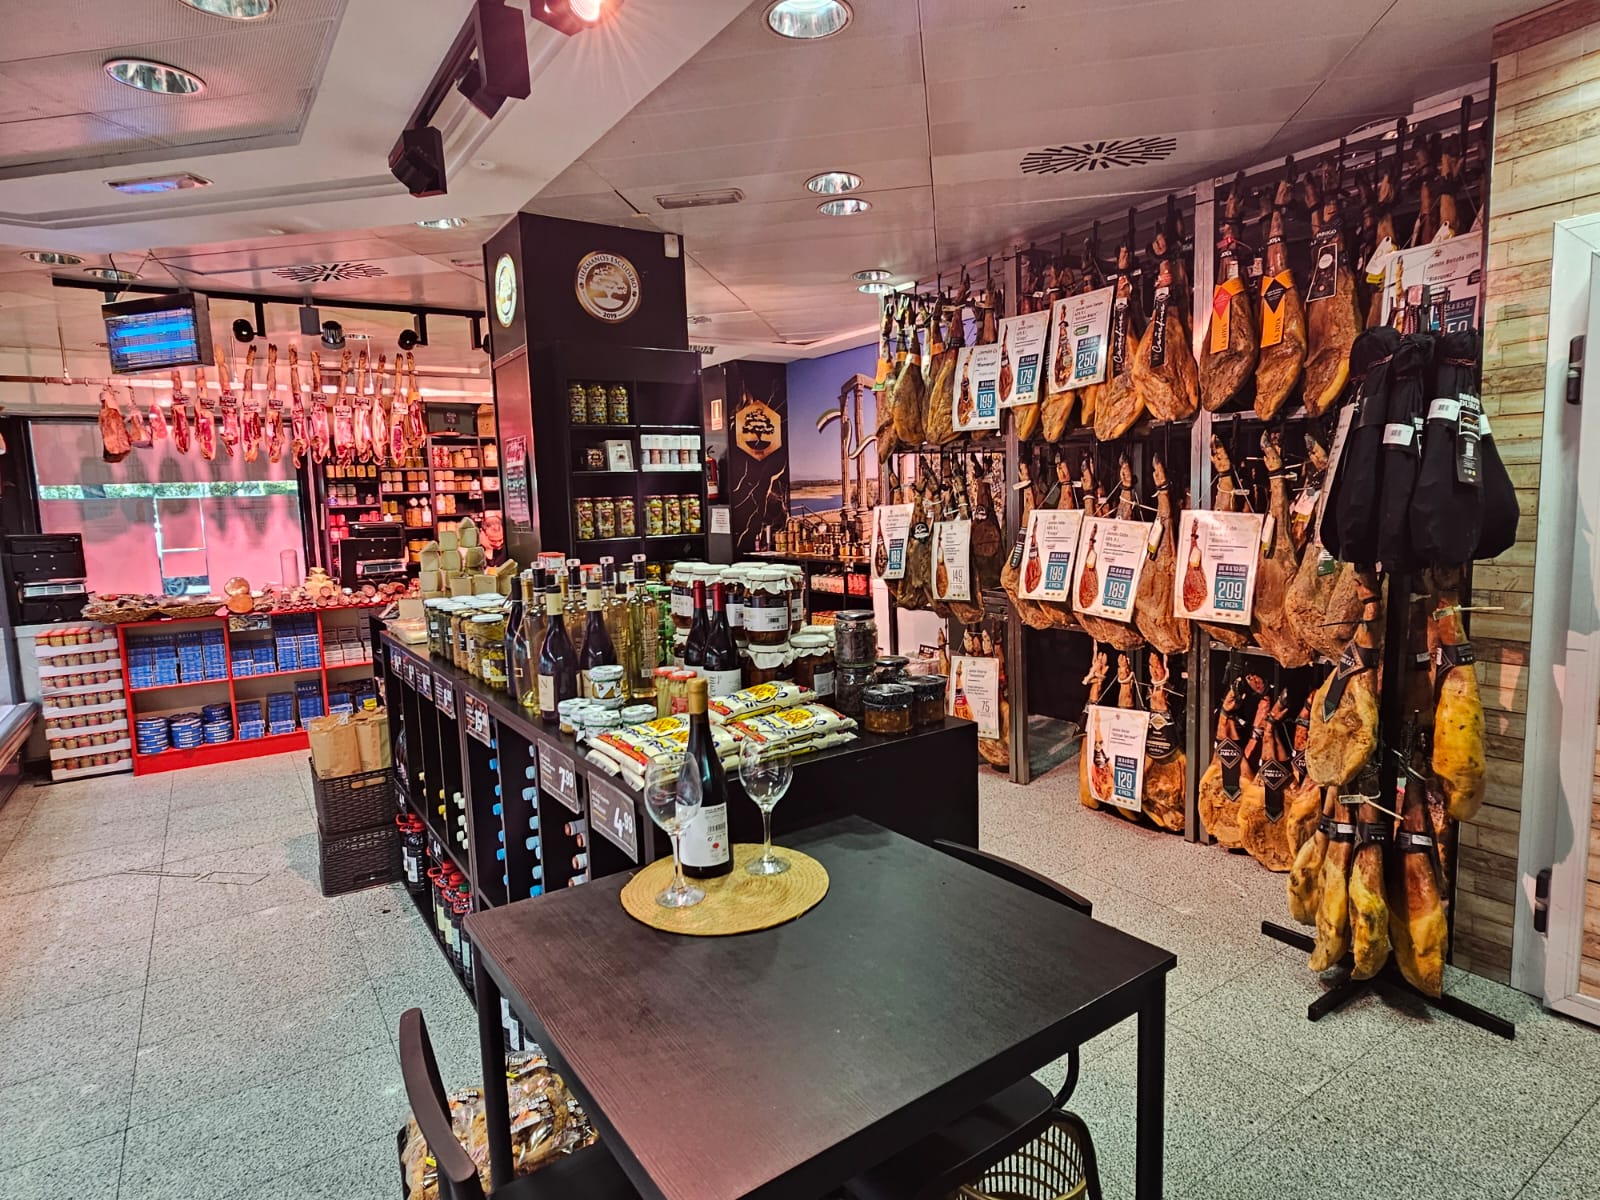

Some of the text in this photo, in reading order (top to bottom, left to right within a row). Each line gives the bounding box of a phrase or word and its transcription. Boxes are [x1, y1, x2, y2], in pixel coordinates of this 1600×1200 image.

[579, 255, 637, 289] HERMANOS ESCUDERO
[1078, 351, 1097, 369] 250
[1020, 369, 1033, 385] 179
[979, 393, 993, 409] 199
[891, 550, 901, 563] 189
[952, 569, 963, 583] 149
[1049, 566, 1064, 581] 199
[1108, 581, 1126, 599] 189
[1218, 581, 1242, 600] 209
[982, 701, 990, 713] 75
[1118, 771, 1132, 789] 129
